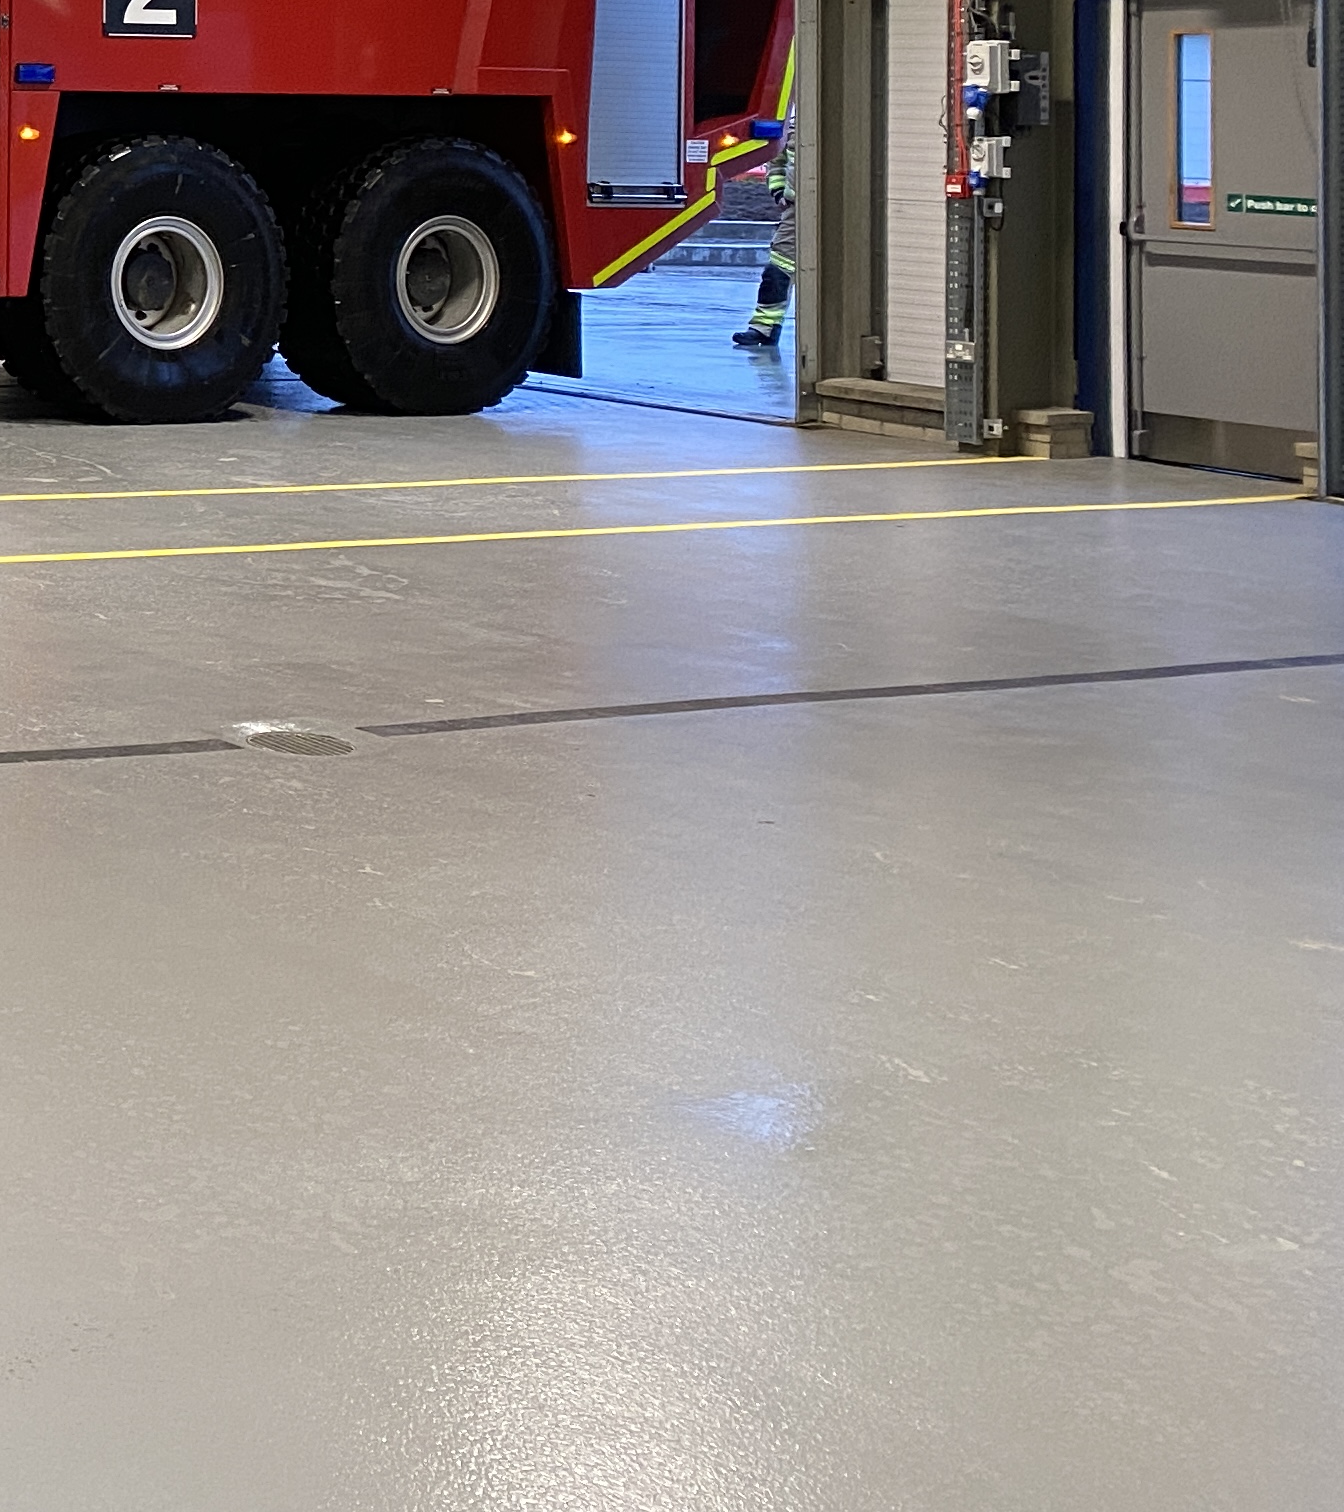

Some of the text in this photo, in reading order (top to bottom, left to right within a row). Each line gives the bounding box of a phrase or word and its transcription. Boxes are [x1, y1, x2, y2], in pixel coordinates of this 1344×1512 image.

[1247, 199, 1274, 210] Push
[1275, 201, 1295, 211] bar
[1297, 203, 1309, 213] to
